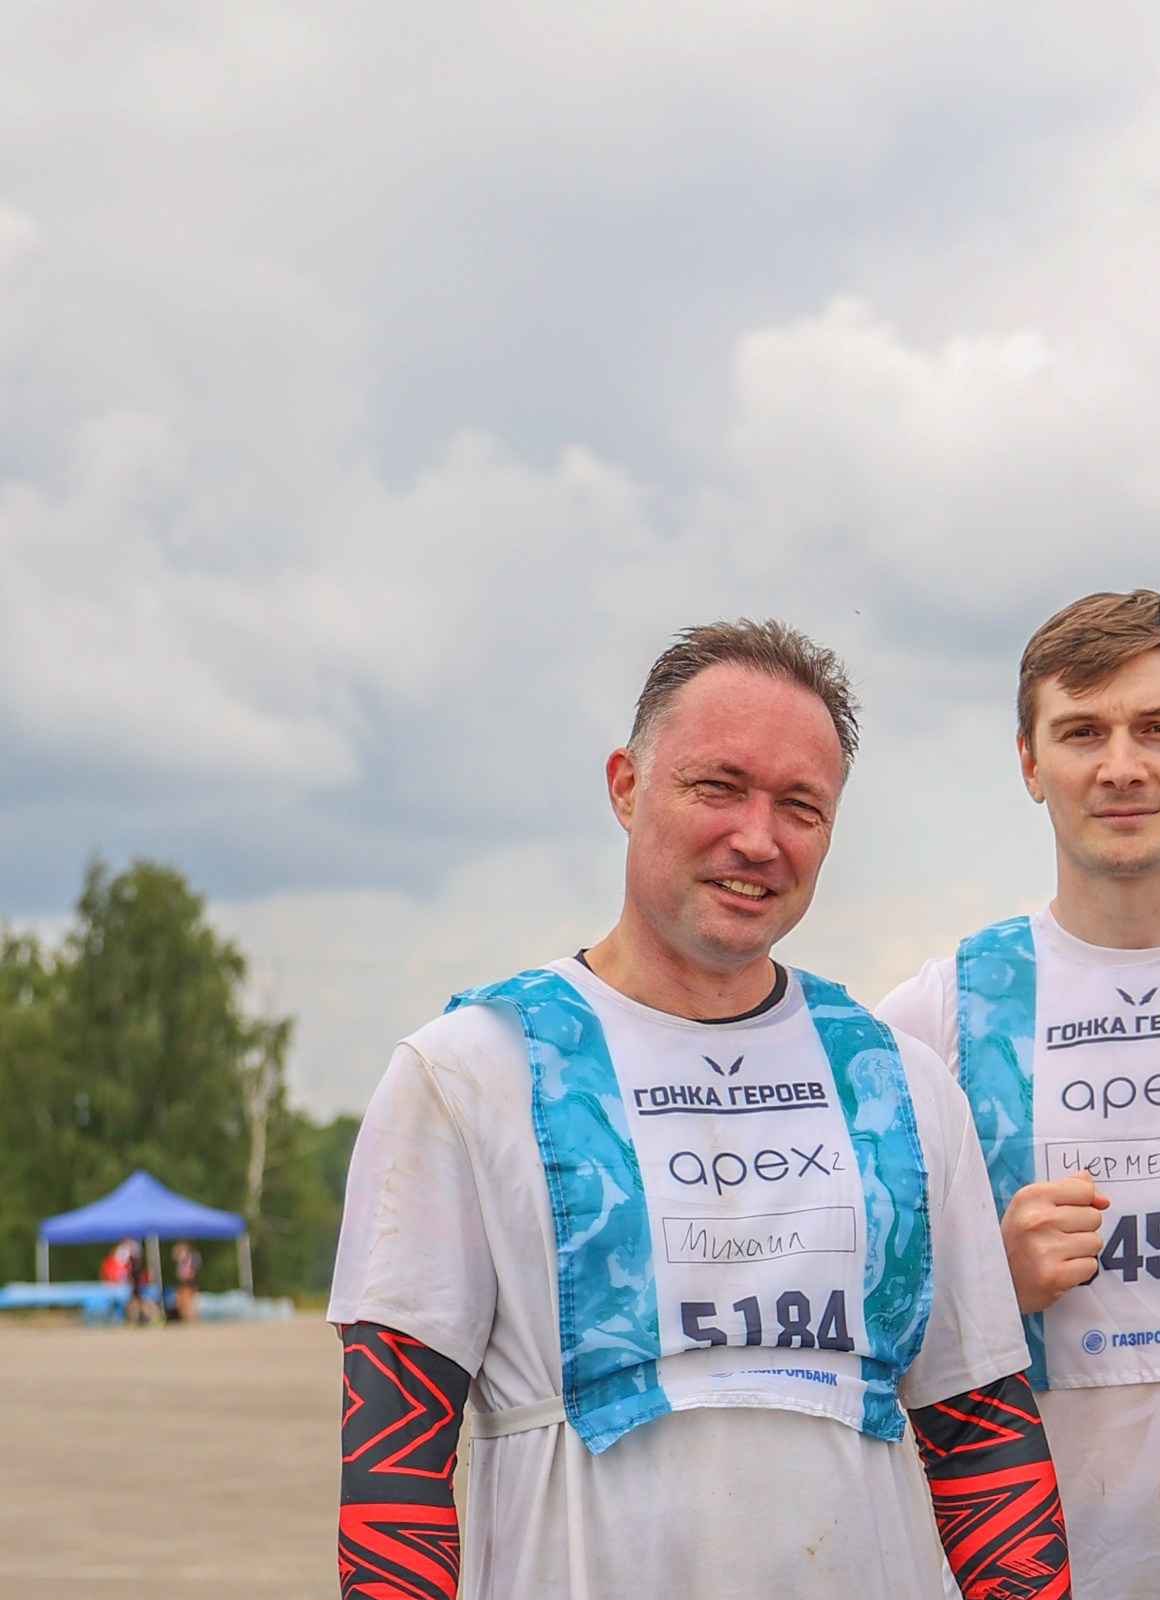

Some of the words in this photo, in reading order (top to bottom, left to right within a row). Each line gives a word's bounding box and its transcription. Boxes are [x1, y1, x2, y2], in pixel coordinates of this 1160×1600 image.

[1046, 1016, 1127, 1044] ГОНКА
[633, 1085, 723, 1108] ГОНКА
[728, 1082, 827, 1106] ГЕРОЕВ
[680, 1221, 807, 1260] Михаил
[680, 1289, 856, 1352] 5184
